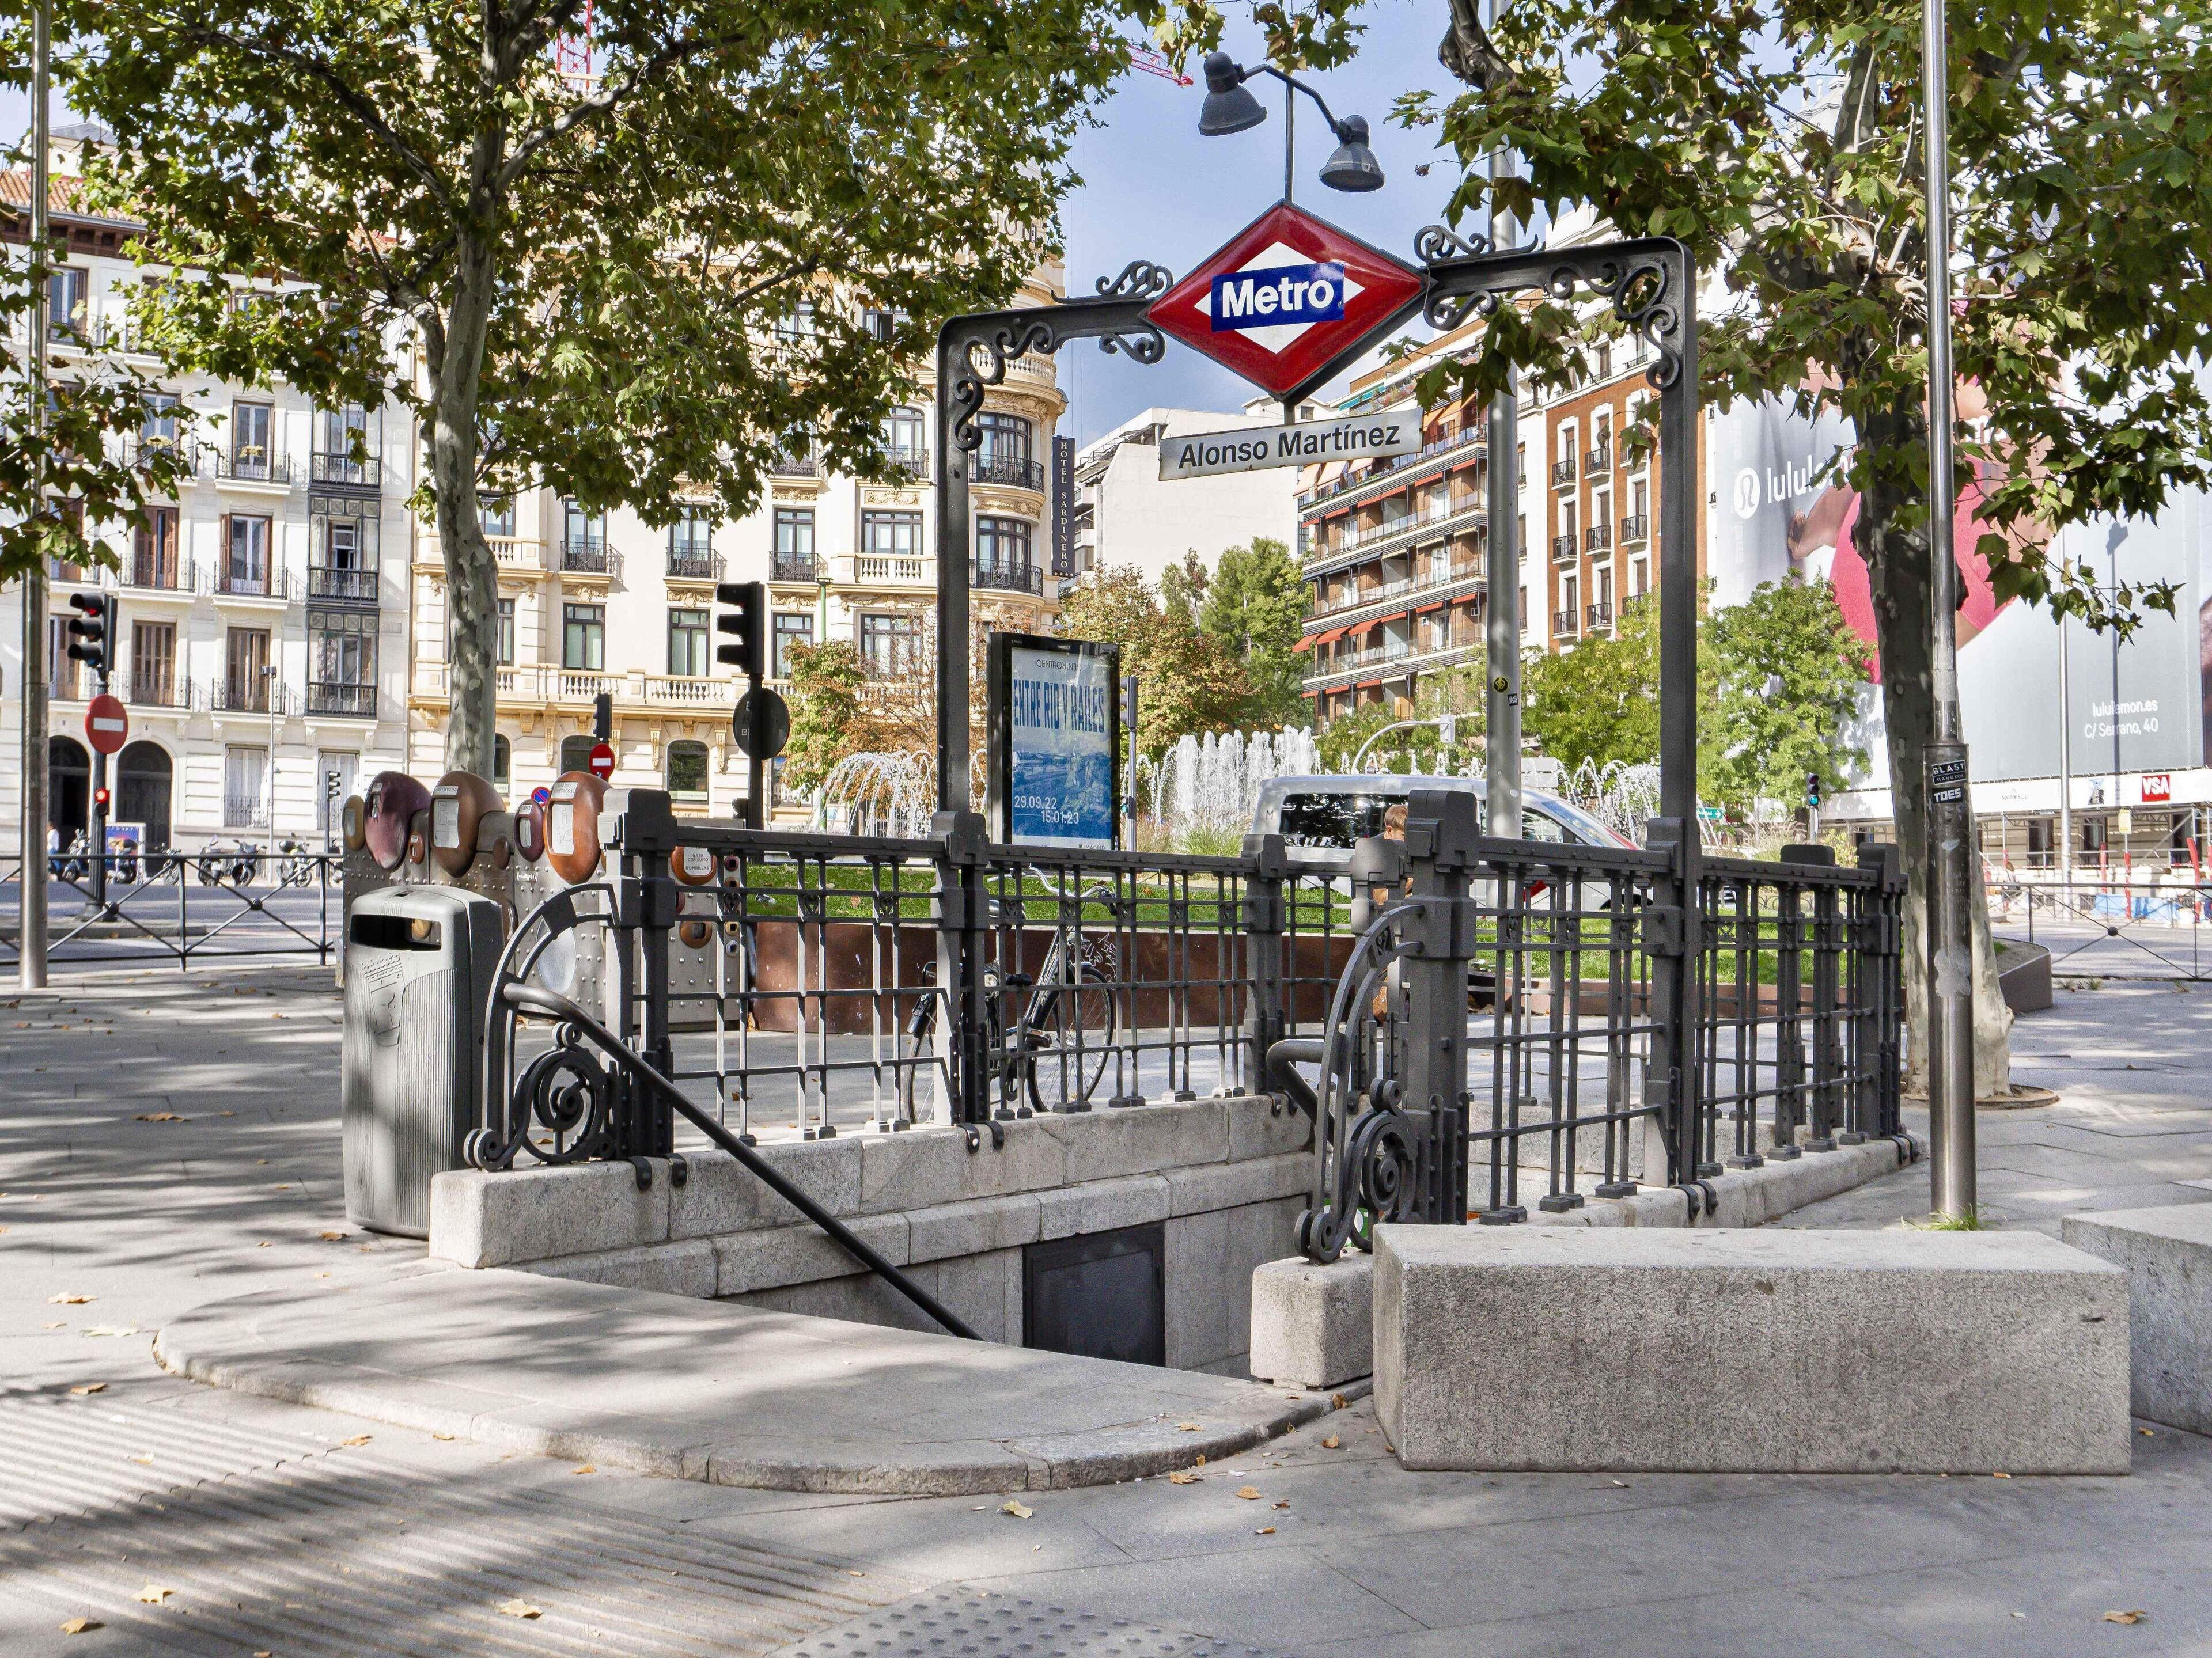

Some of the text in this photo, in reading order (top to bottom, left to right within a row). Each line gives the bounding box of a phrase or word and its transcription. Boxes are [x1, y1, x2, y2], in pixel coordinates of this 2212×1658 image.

[1222, 277, 1334, 318] Metro
[1178, 424, 1401, 469] Alonso Martínez
[1014, 679, 1040, 728] ENTRE
[1062, 684, 1067, 730] Y
[2092, 700, 2158, 718] lululemon.es
[2084, 717, 2158, 739] C/ Serrano, 40
[1933, 763, 1964, 775] BLAST
[2142, 776, 2169, 795] VSA
[1014, 795, 1057, 810] 29.09.22
[1934, 788, 1961, 802] TOES
[1041, 810, 1079, 824] 15.01.23
[1266, 810, 1274, 820] M
